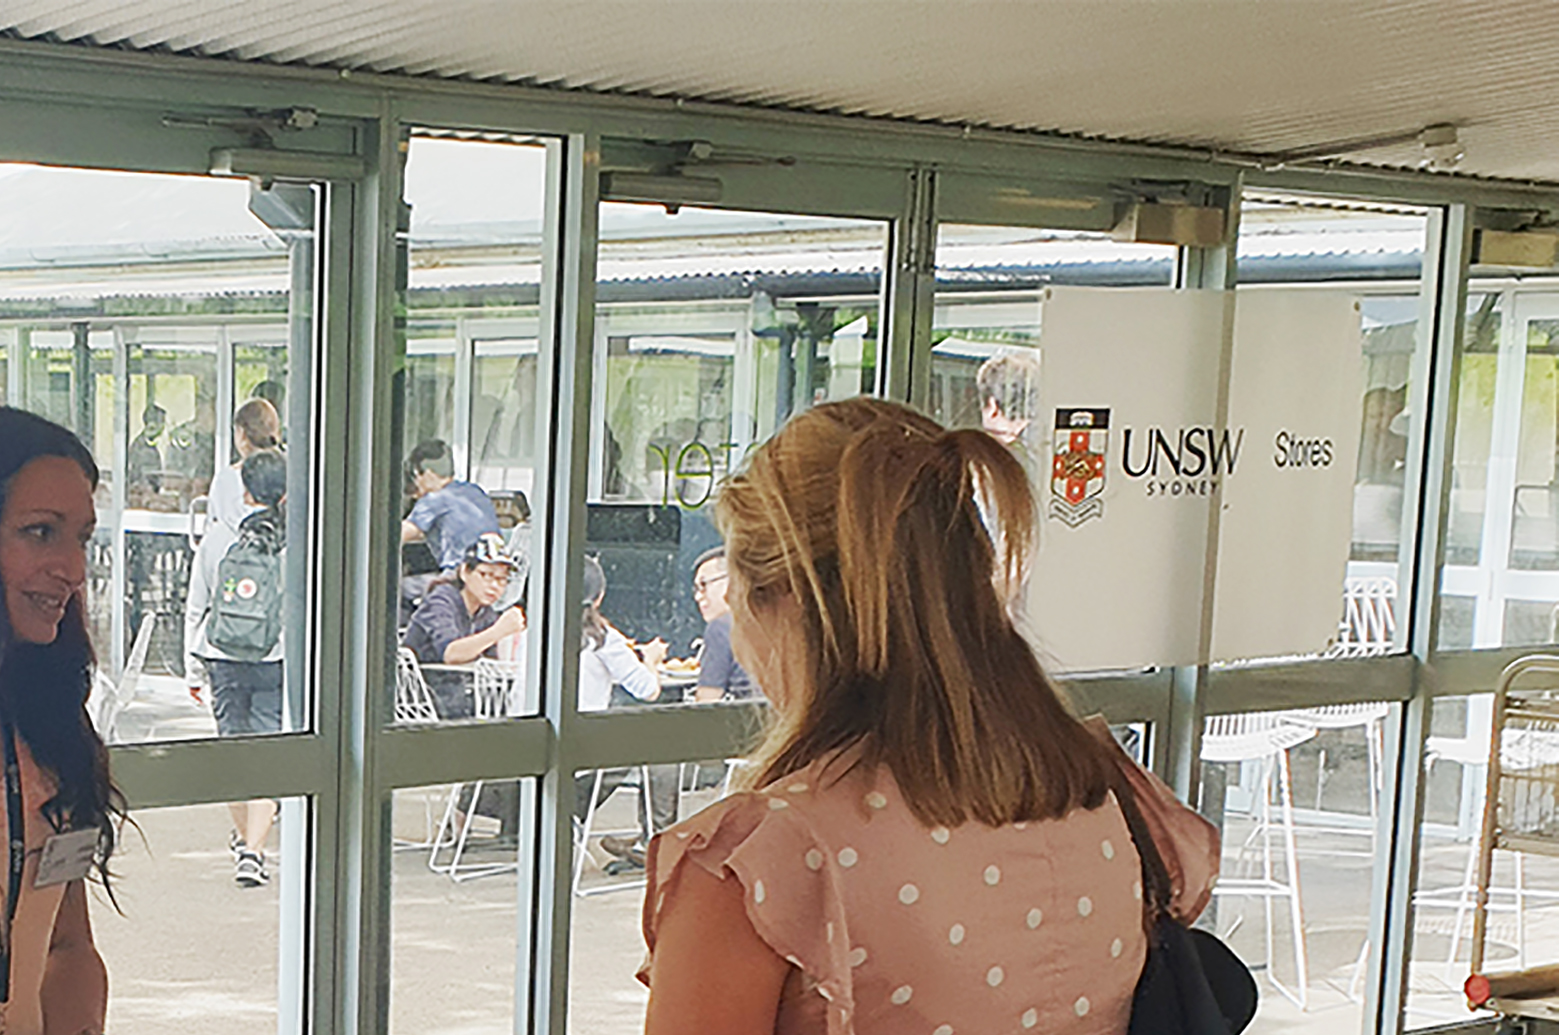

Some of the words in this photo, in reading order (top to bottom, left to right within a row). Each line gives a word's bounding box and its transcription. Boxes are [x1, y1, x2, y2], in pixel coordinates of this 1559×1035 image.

[1122, 428, 1244, 478] UNSW
[1273, 430, 1334, 468] Stores
[1146, 480, 1220, 496] SYDNEY
